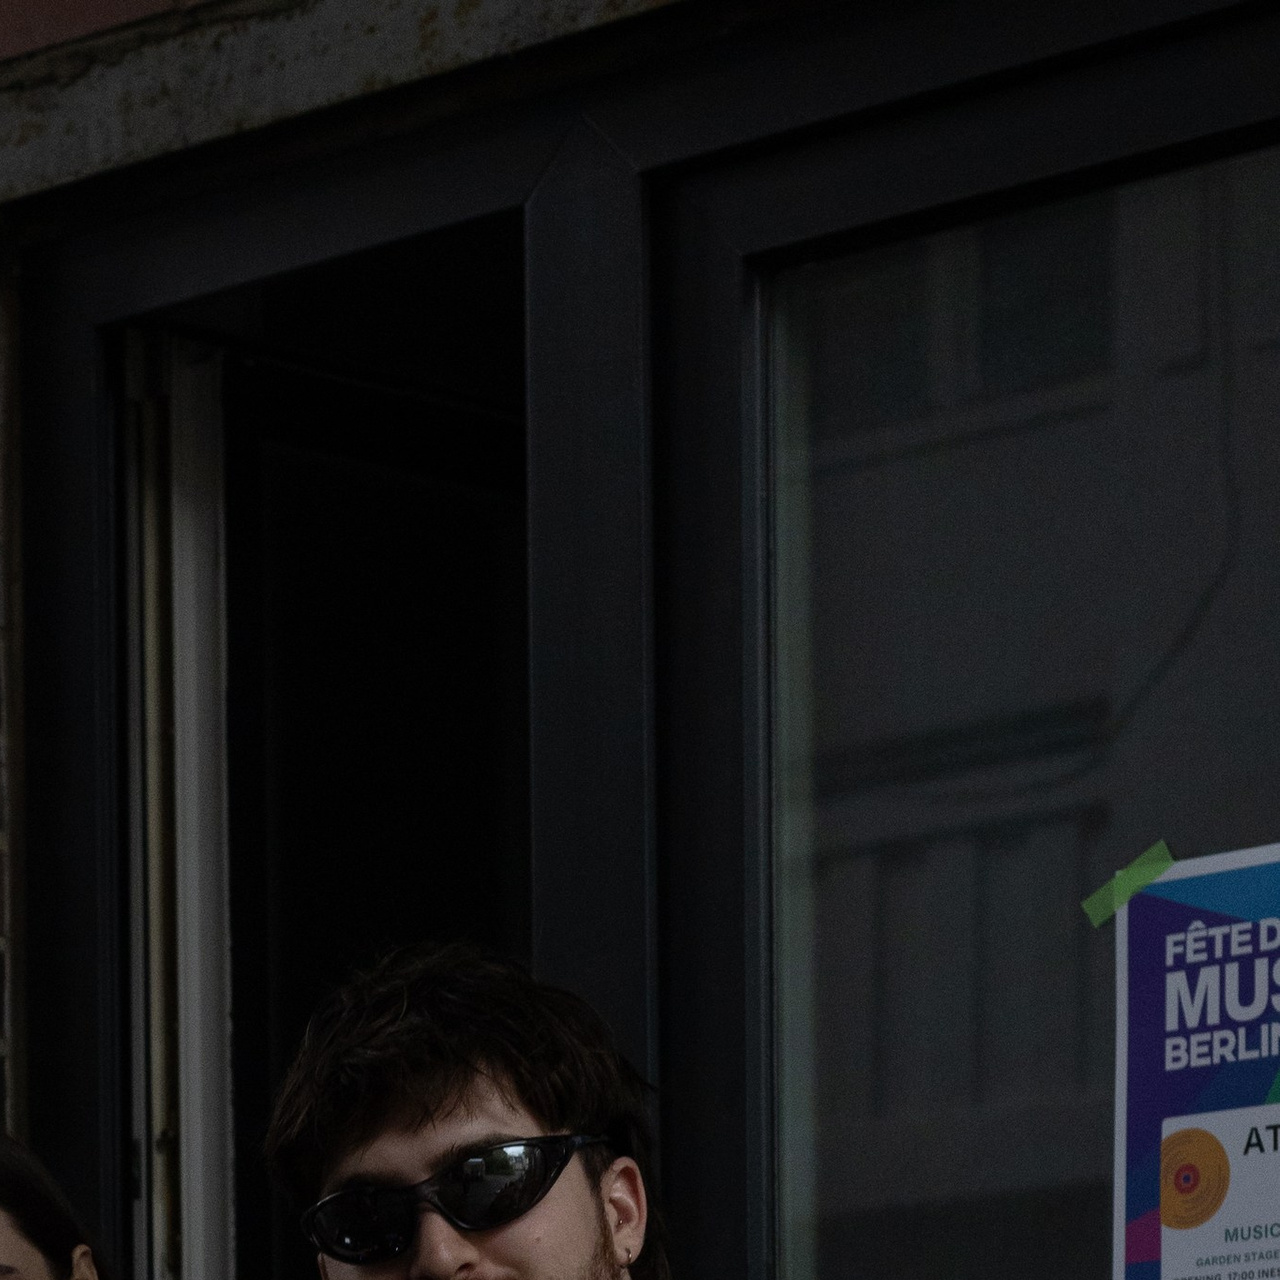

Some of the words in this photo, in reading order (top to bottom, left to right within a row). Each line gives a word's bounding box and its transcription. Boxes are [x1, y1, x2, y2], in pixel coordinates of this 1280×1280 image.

[1165, 920, 1253, 967] FÊTE
[1165, 957, 1280, 1032] MU
[1196, 1253, 1241, 1267] GARDEN
[1244, 1250, 1280, 1263] STAGE
